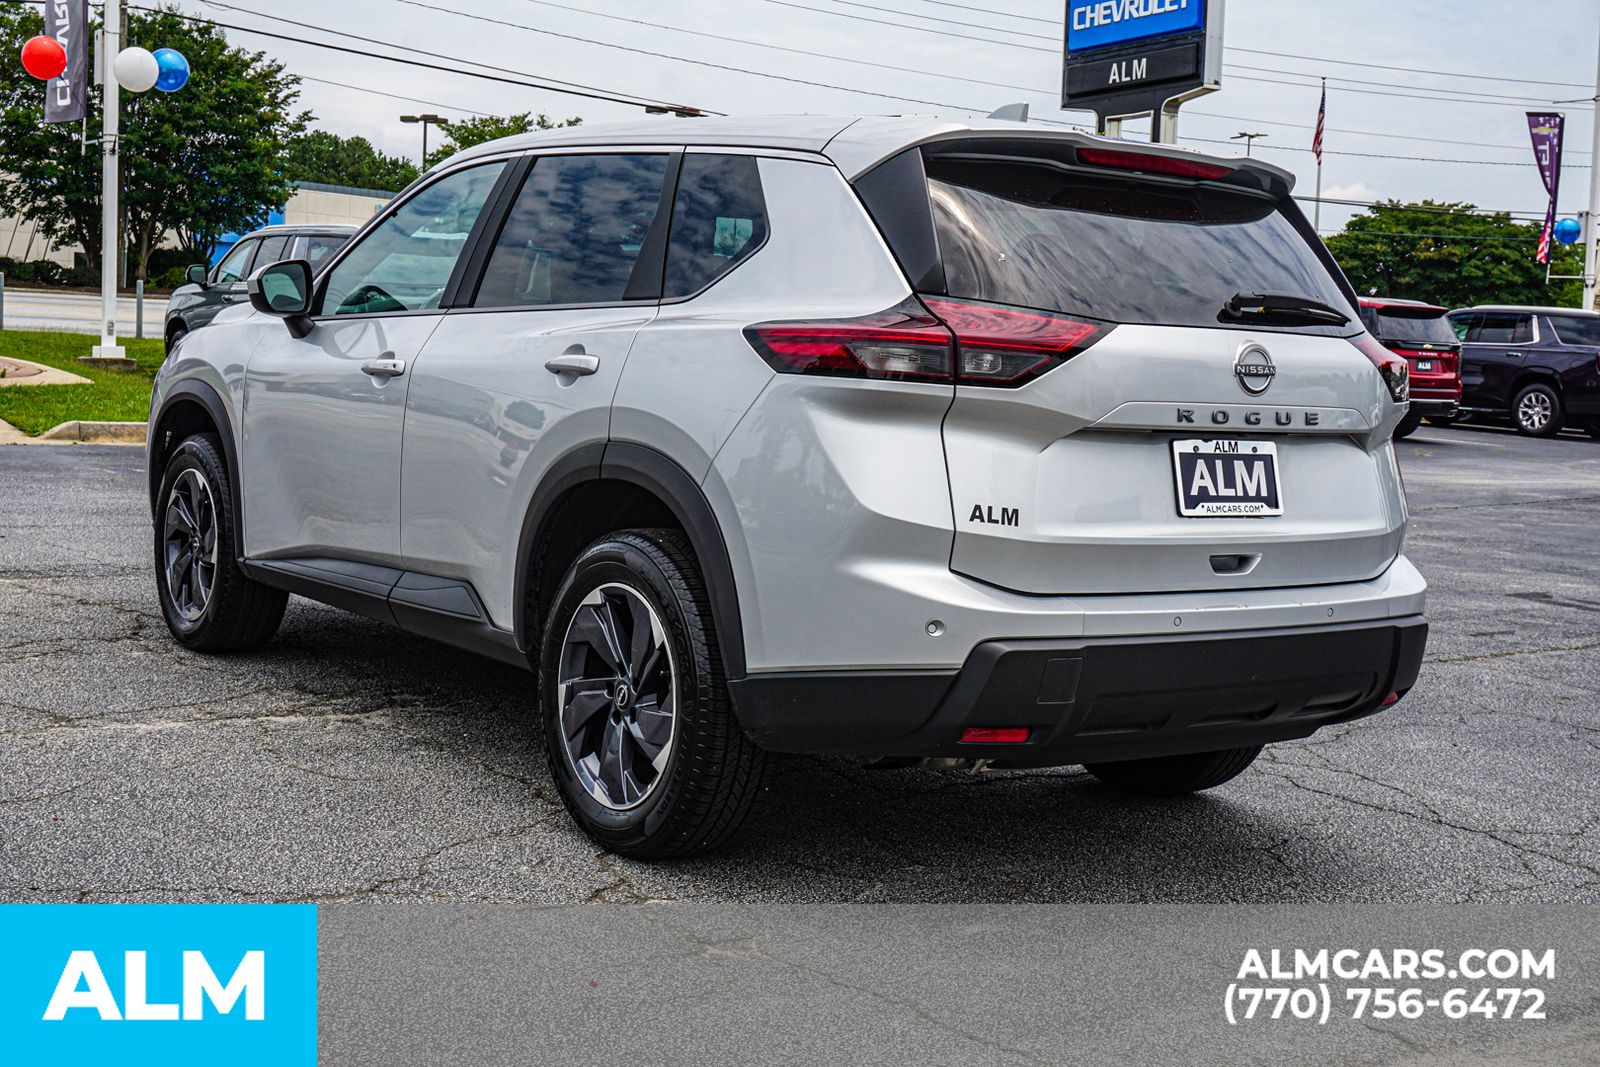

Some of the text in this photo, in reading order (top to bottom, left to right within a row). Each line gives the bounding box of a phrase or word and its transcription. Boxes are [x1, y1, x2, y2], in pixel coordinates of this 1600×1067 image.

[1108, 58, 1147, 84] ALM
[1237, 365, 1275, 374] NISSAN
[1177, 408, 1319, 425] ROGUE
[1214, 441, 1239, 453] ALM
[1190, 459, 1268, 497] ALM
[969, 504, 1019, 527] ALM
[1206, 505, 1261, 513] ALMCARS.COM
